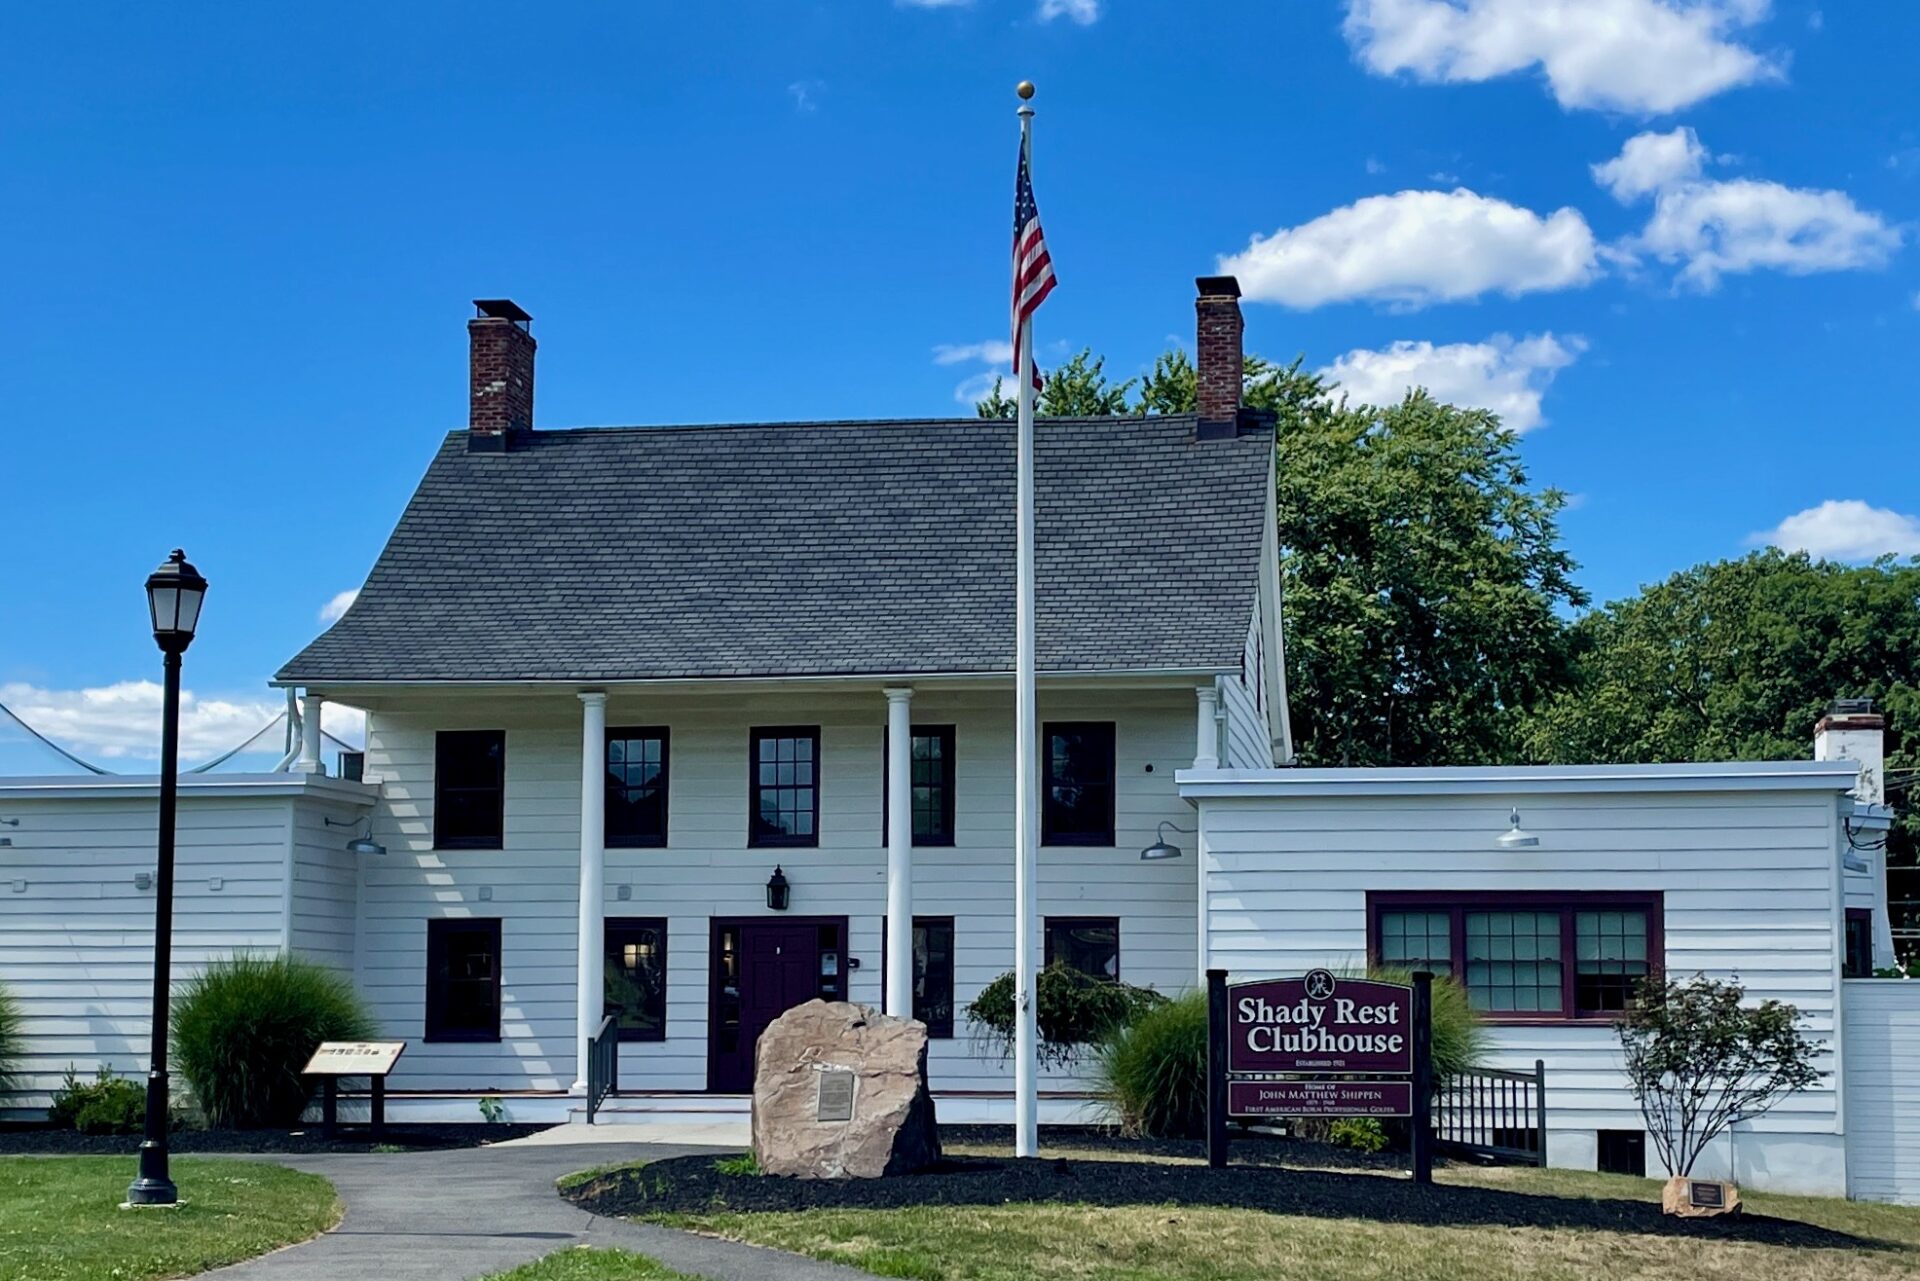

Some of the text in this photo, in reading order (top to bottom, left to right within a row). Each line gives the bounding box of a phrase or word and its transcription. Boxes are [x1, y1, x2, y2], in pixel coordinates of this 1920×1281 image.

[1238, 997, 1399, 1029] Shady Rest
[1247, 1026, 1403, 1053] Clubhouse
[1259, 1089, 1382, 1101] JOHN MATTHEW SHIPPEN
[1245, 1105, 1263, 1113] FIRST
[1265, 1105, 1301, 1113] AMERICAN
[1303, 1105, 1322, 1113] BORN
[1369, 1105, 1396, 1113] GOLFER
